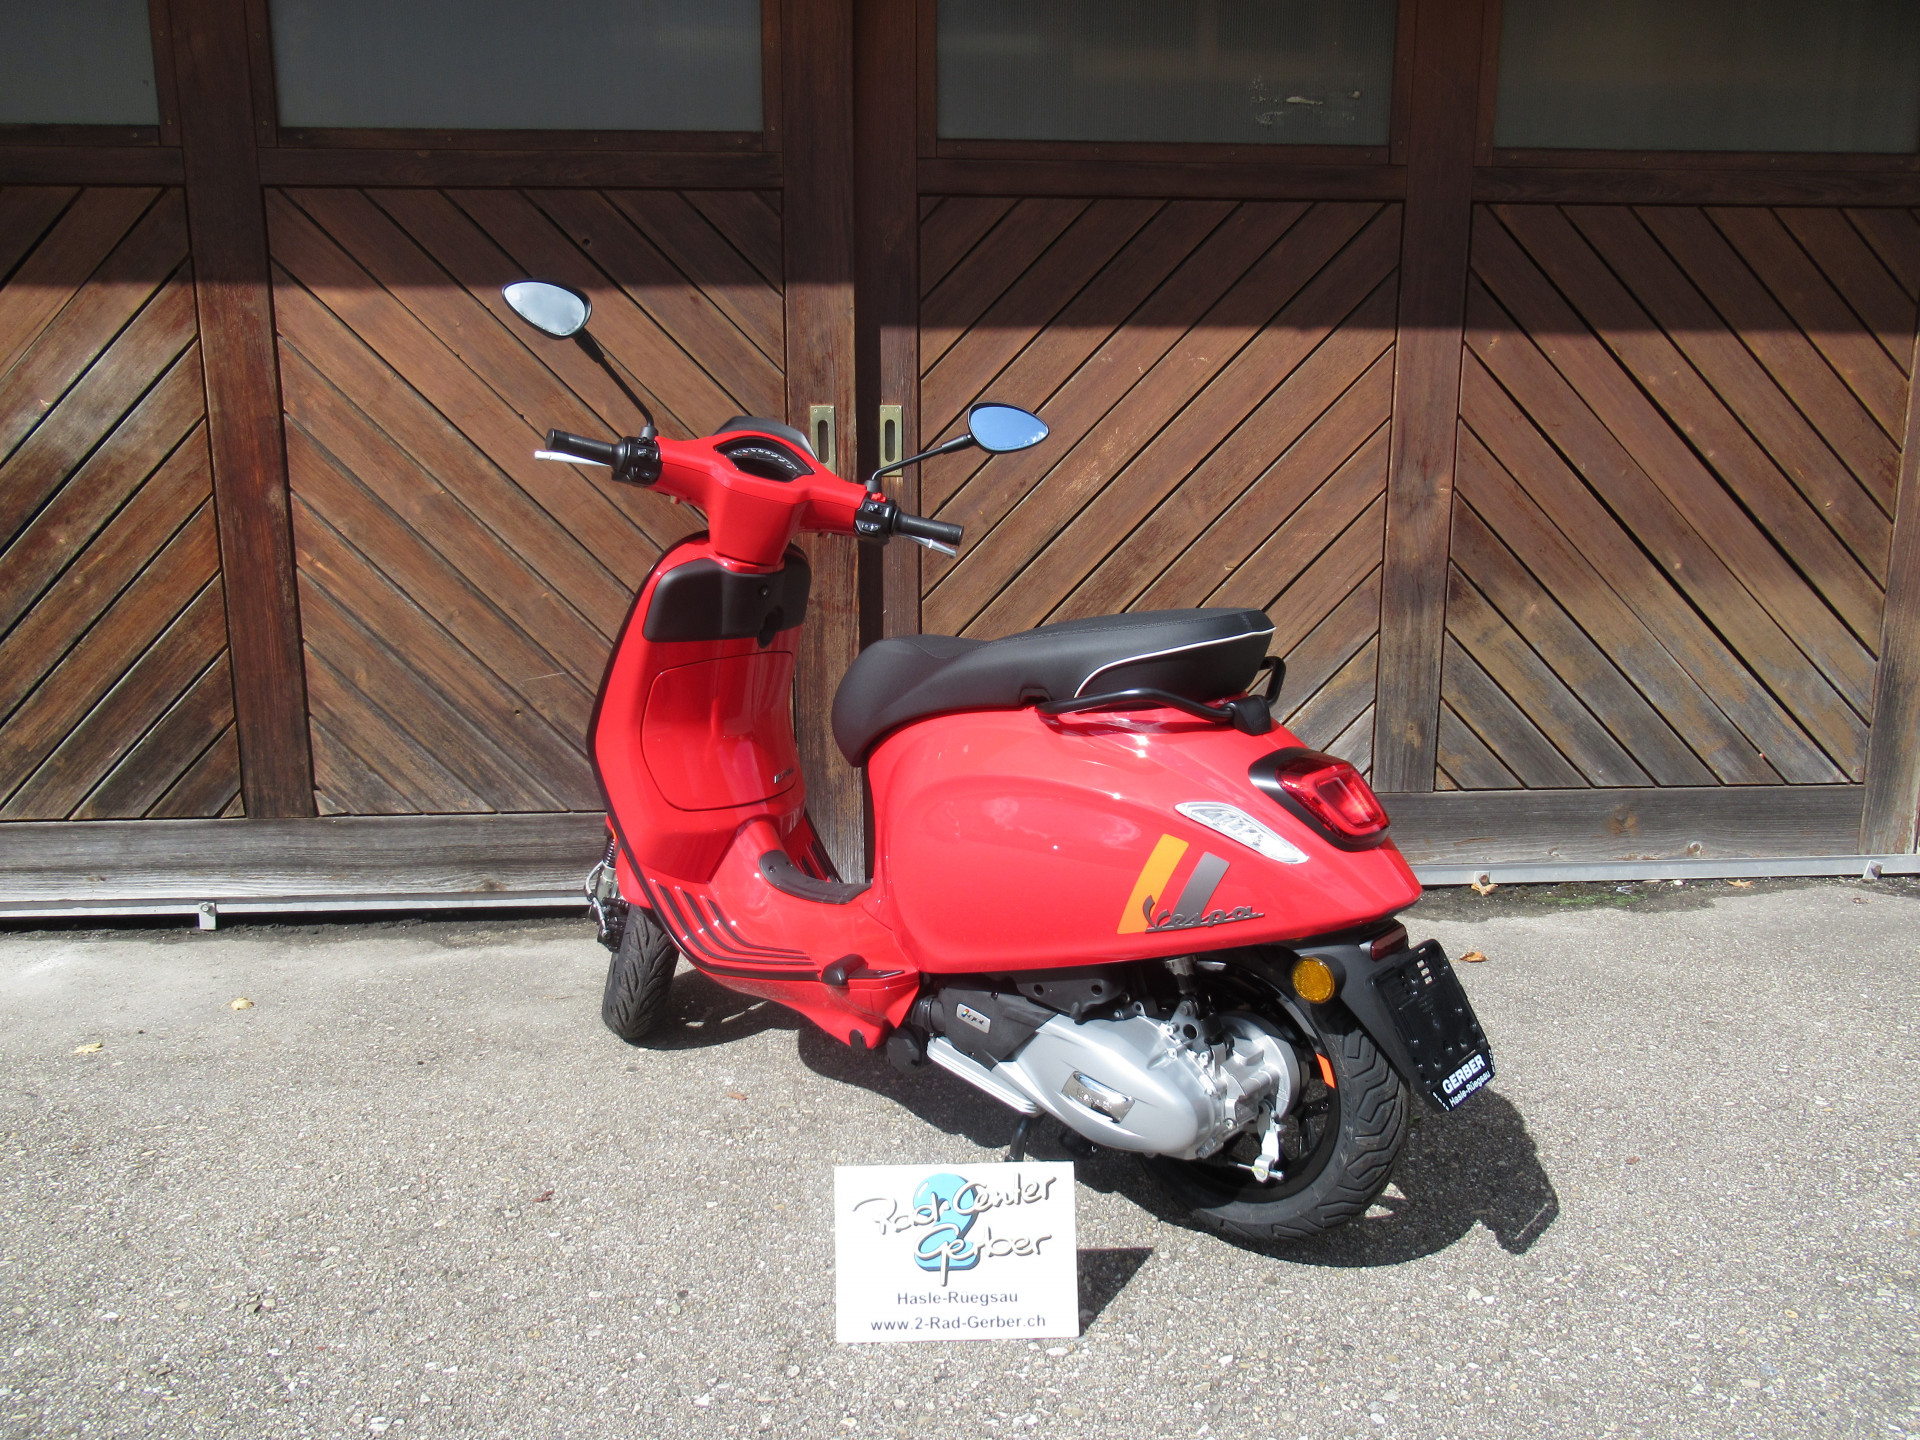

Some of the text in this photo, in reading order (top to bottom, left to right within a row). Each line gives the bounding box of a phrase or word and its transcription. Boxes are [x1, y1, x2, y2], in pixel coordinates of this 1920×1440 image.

[1142, 894, 1265, 933] Vespa
[1442, 1053, 1486, 1095] GERBER
[1448, 1070, 1491, 1108] Hasle-Rüegsau
[852, 1172, 1057, 1236] Rad Center
[915, 1223, 1052, 1287] Gerber
[897, 1290, 1018, 1306] Hasle-Rüegsau
[870, 1314, 1046, 1331] www.2-Rad-Gerber.ch
